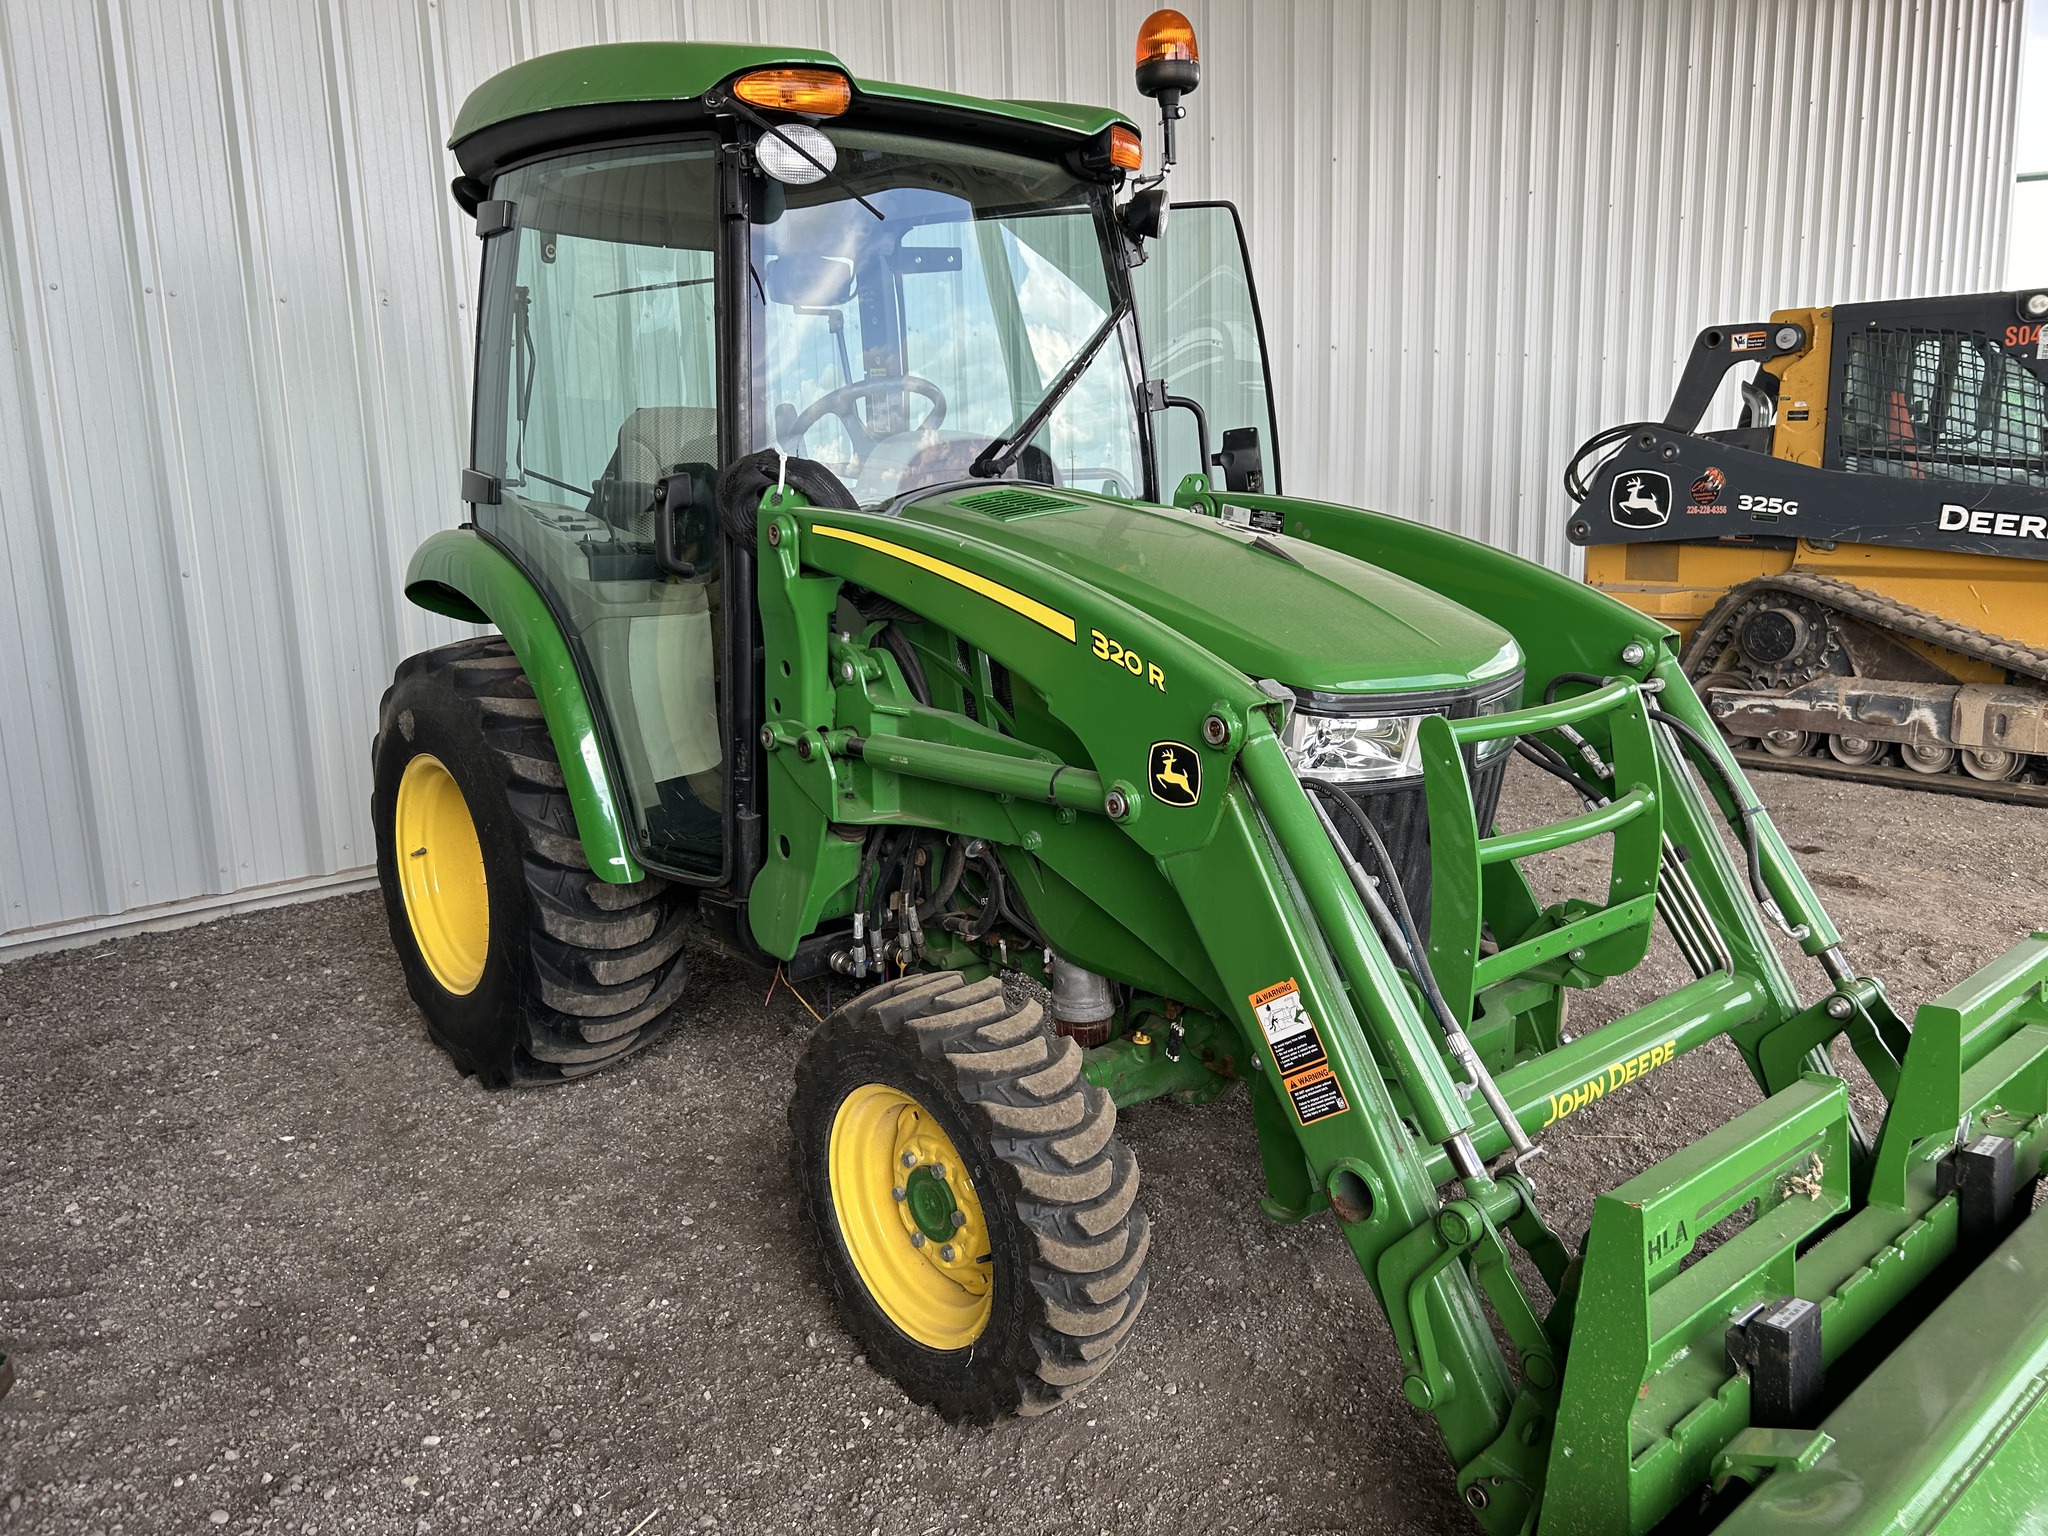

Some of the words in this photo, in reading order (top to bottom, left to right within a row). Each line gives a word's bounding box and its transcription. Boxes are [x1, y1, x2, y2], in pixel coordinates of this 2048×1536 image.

[1738, 494, 1799, 515] 325G
[1938, 503, 2048, 540] DEER
[1091, 628, 1143, 676] 320
[1148, 661, 1166, 693] R
[1262, 983, 1292, 1001] WARNING
[1298, 1069, 1329, 1086] WARNING
[1543, 1076, 1605, 1127] JOHN
[1607, 1039, 1677, 1093] DEERE
[1647, 1220, 1688, 1266] HLA
